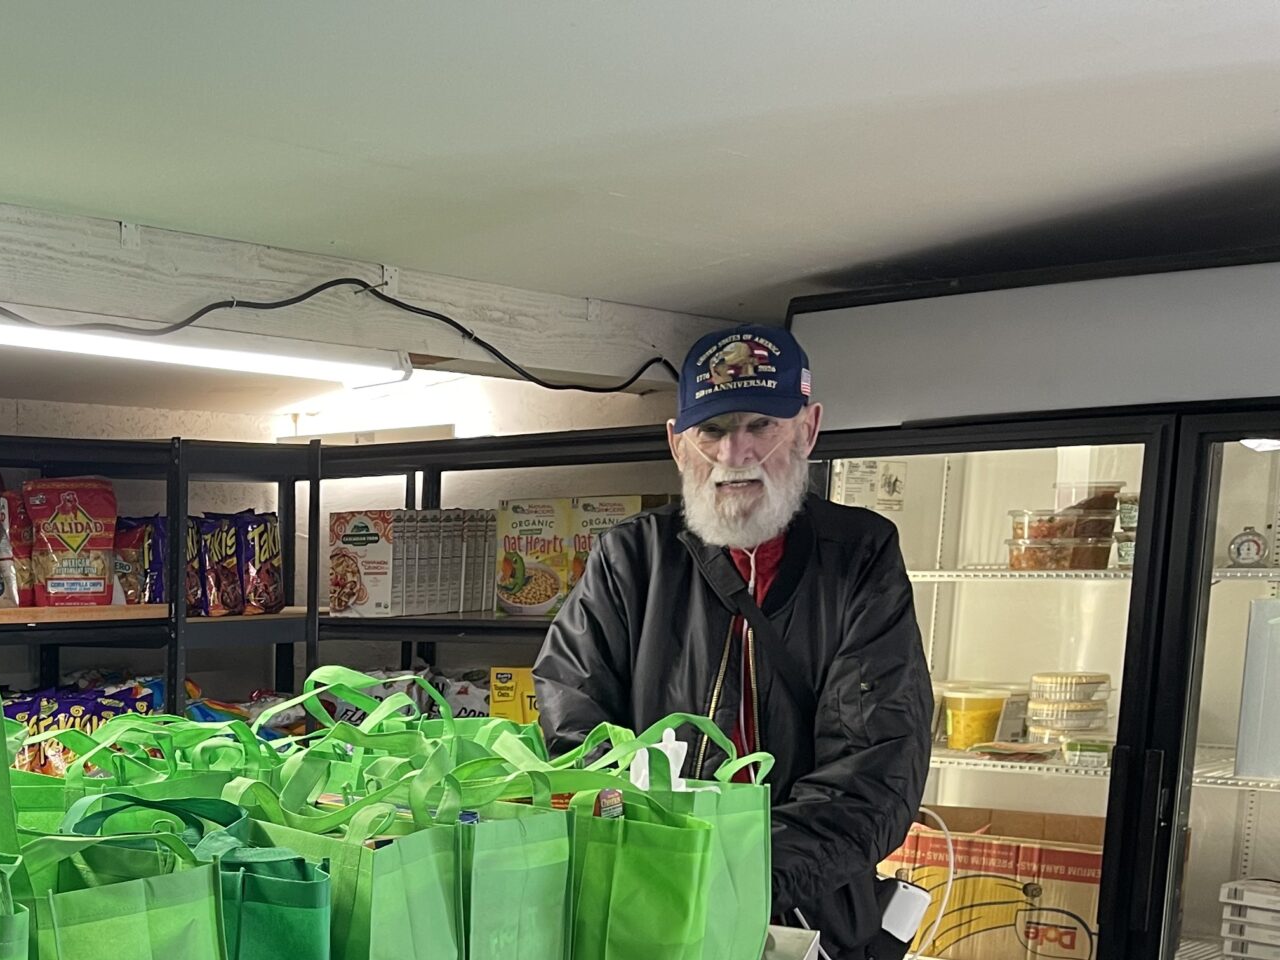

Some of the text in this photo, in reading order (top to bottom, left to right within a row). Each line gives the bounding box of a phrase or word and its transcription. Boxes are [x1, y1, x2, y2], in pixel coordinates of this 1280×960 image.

[713, 380, 778, 392] ANNIVERSARY
[42, 521, 104, 534] CALIDAD
[511, 520, 555, 529] ORGANIC
[526, 535, 563, 556] Hearts
[1024, 926, 1077, 950] Dole
